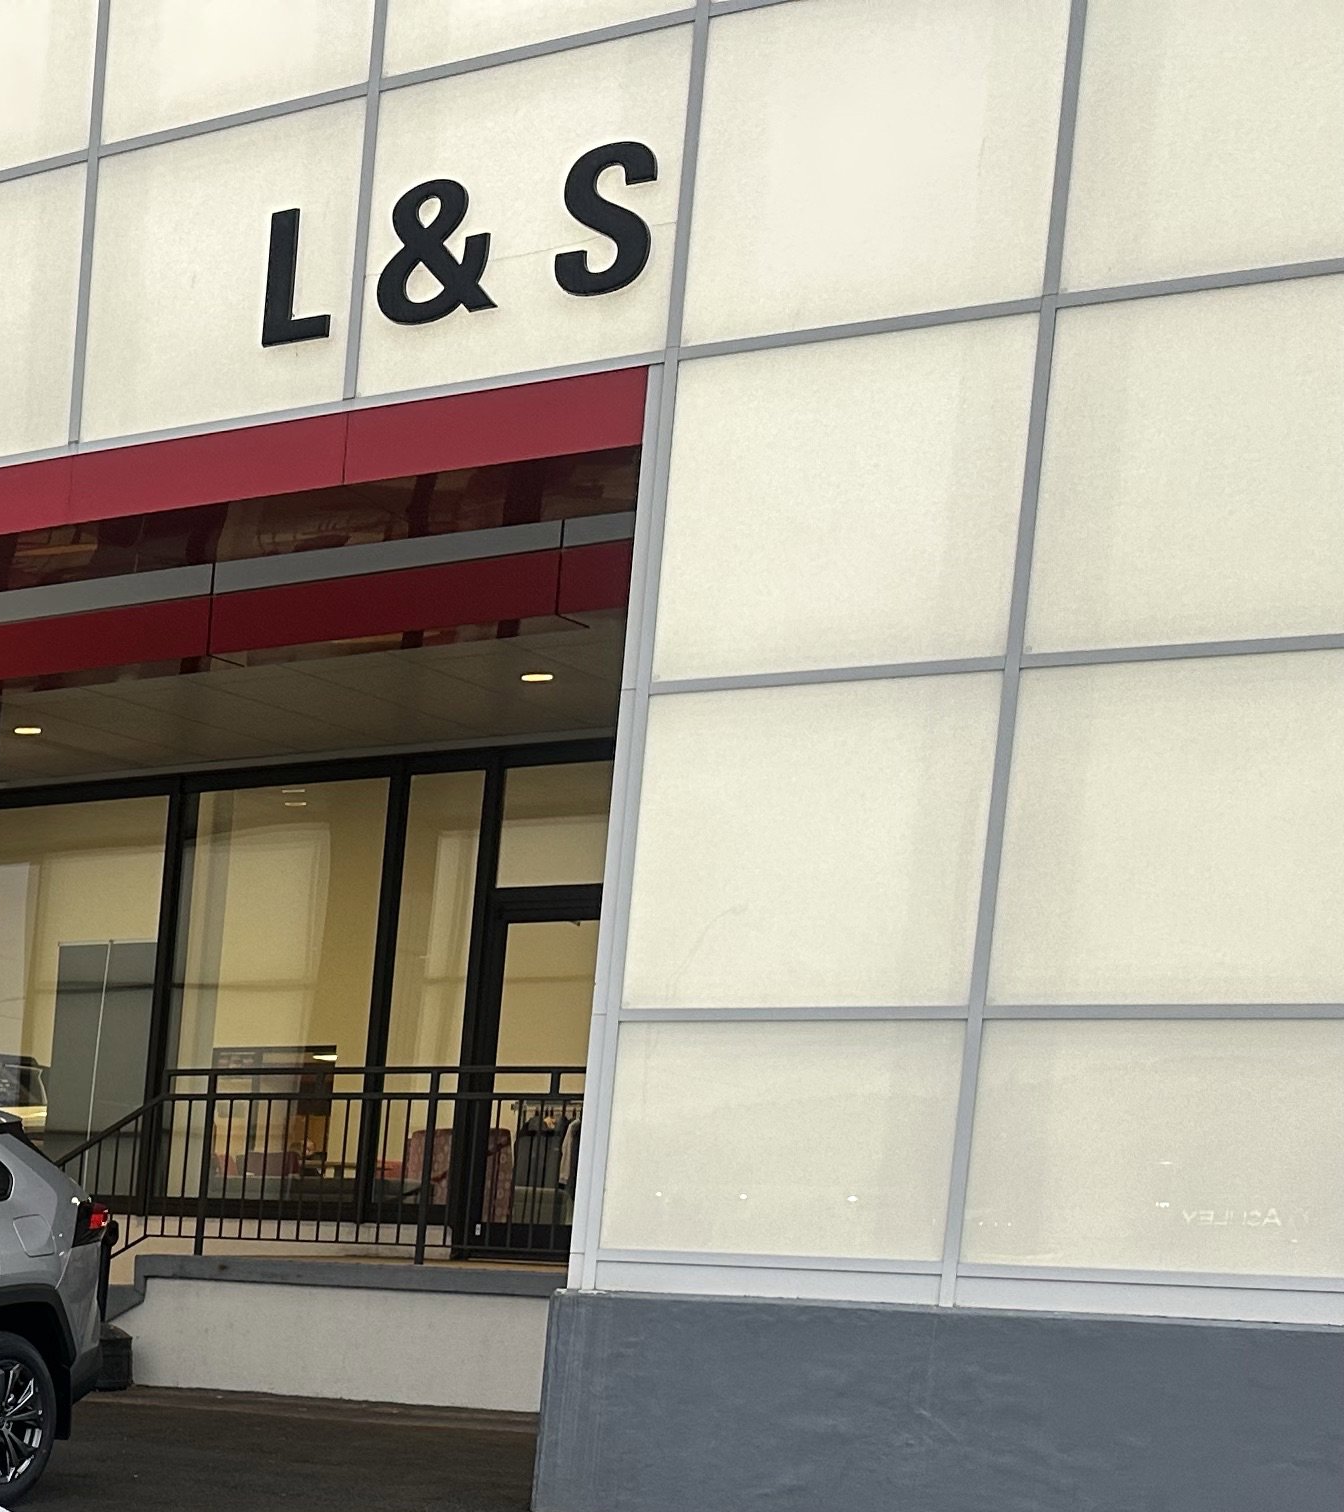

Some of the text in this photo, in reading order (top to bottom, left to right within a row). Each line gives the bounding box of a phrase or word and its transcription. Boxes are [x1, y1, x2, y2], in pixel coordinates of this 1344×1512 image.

[262, 141, 658, 348] L & S
